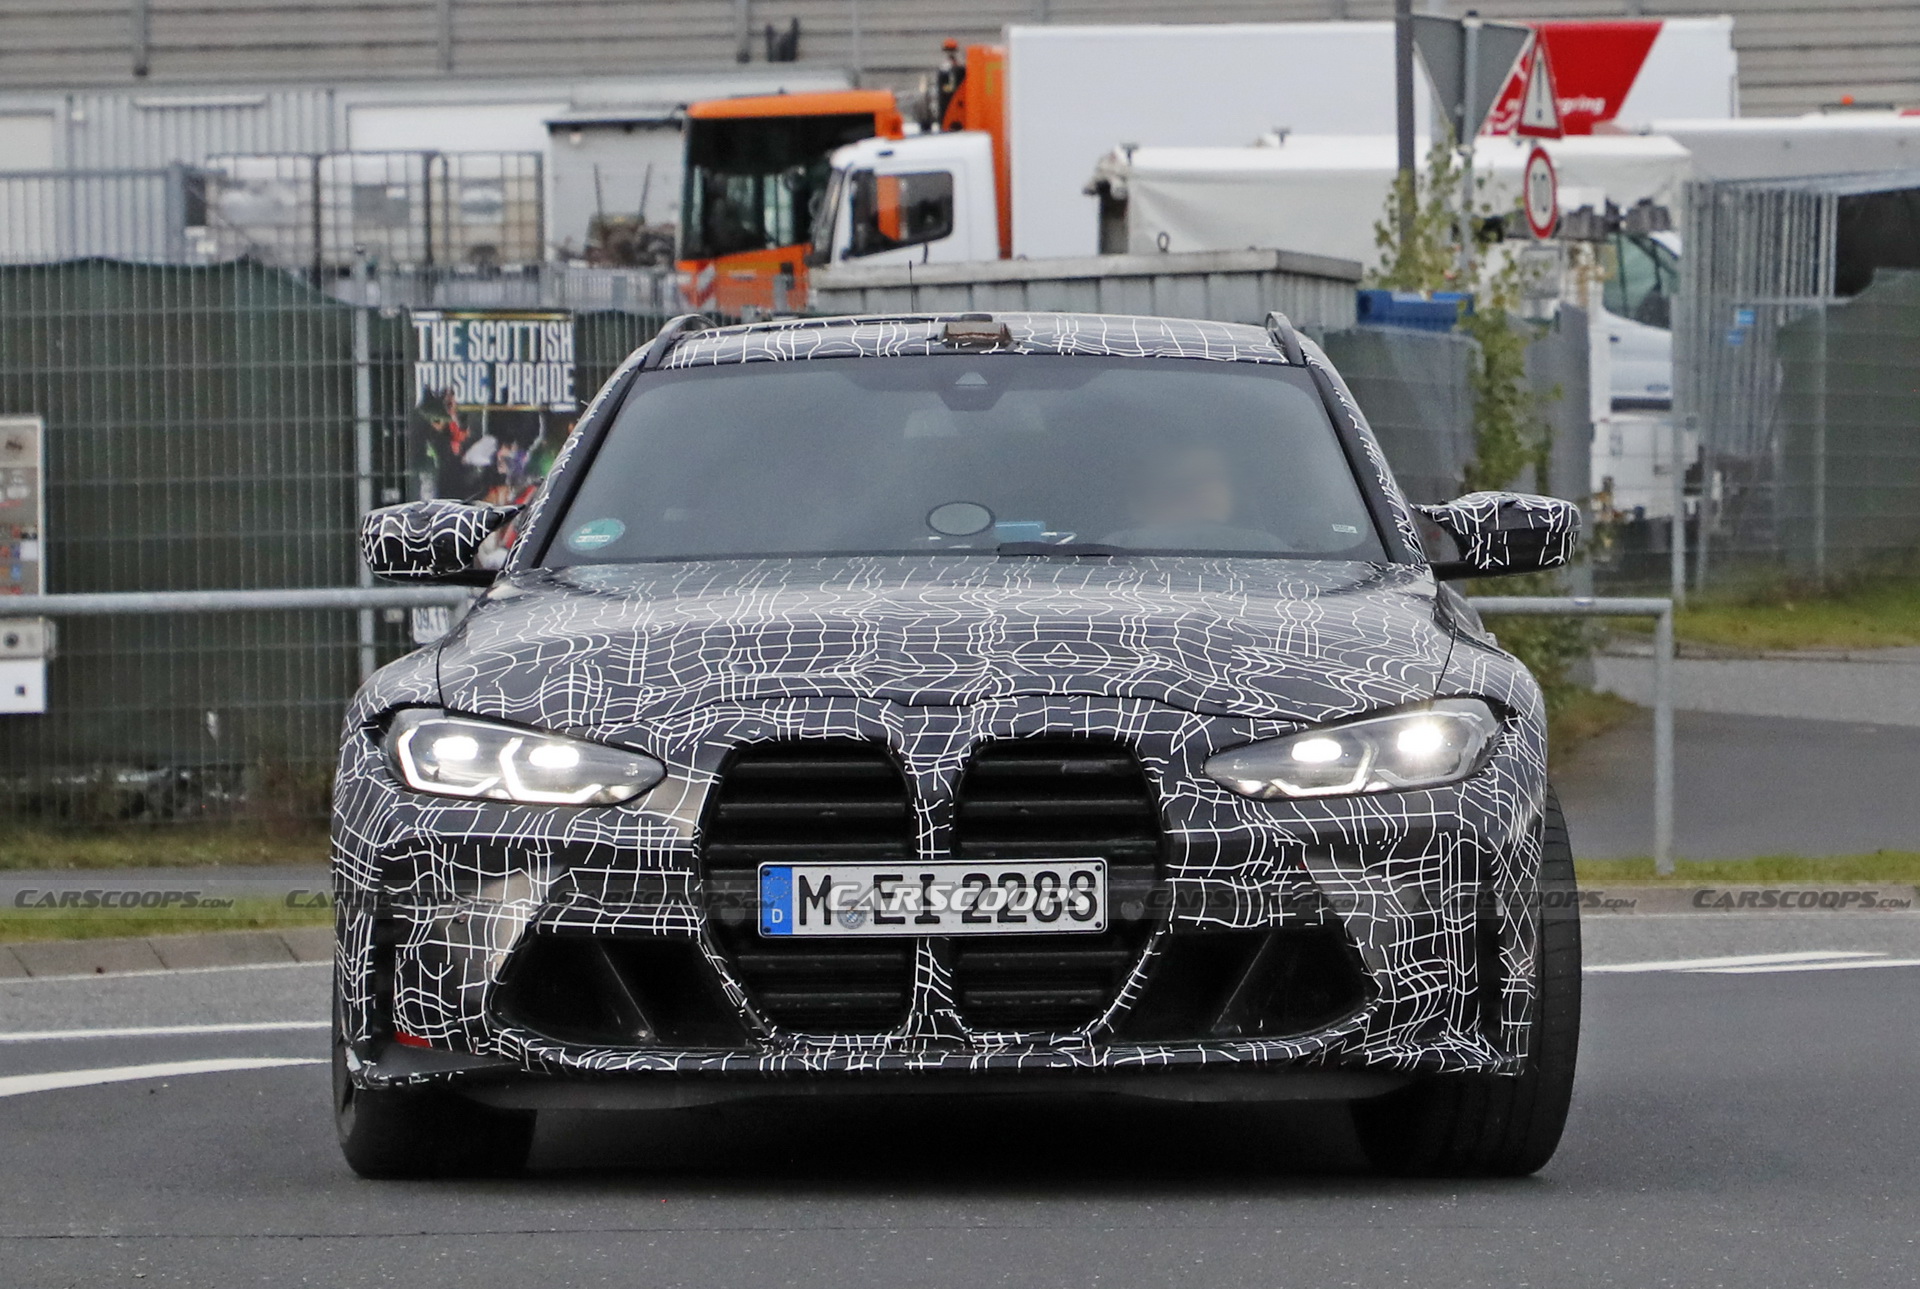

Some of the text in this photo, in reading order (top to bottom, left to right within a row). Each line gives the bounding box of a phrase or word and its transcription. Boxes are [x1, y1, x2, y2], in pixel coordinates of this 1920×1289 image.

[412, 320, 574, 362] THE SCOTTISH
[414, 362, 576, 407] MUSIC PARADE
[771, 870, 1098, 926] D M EI 2288
